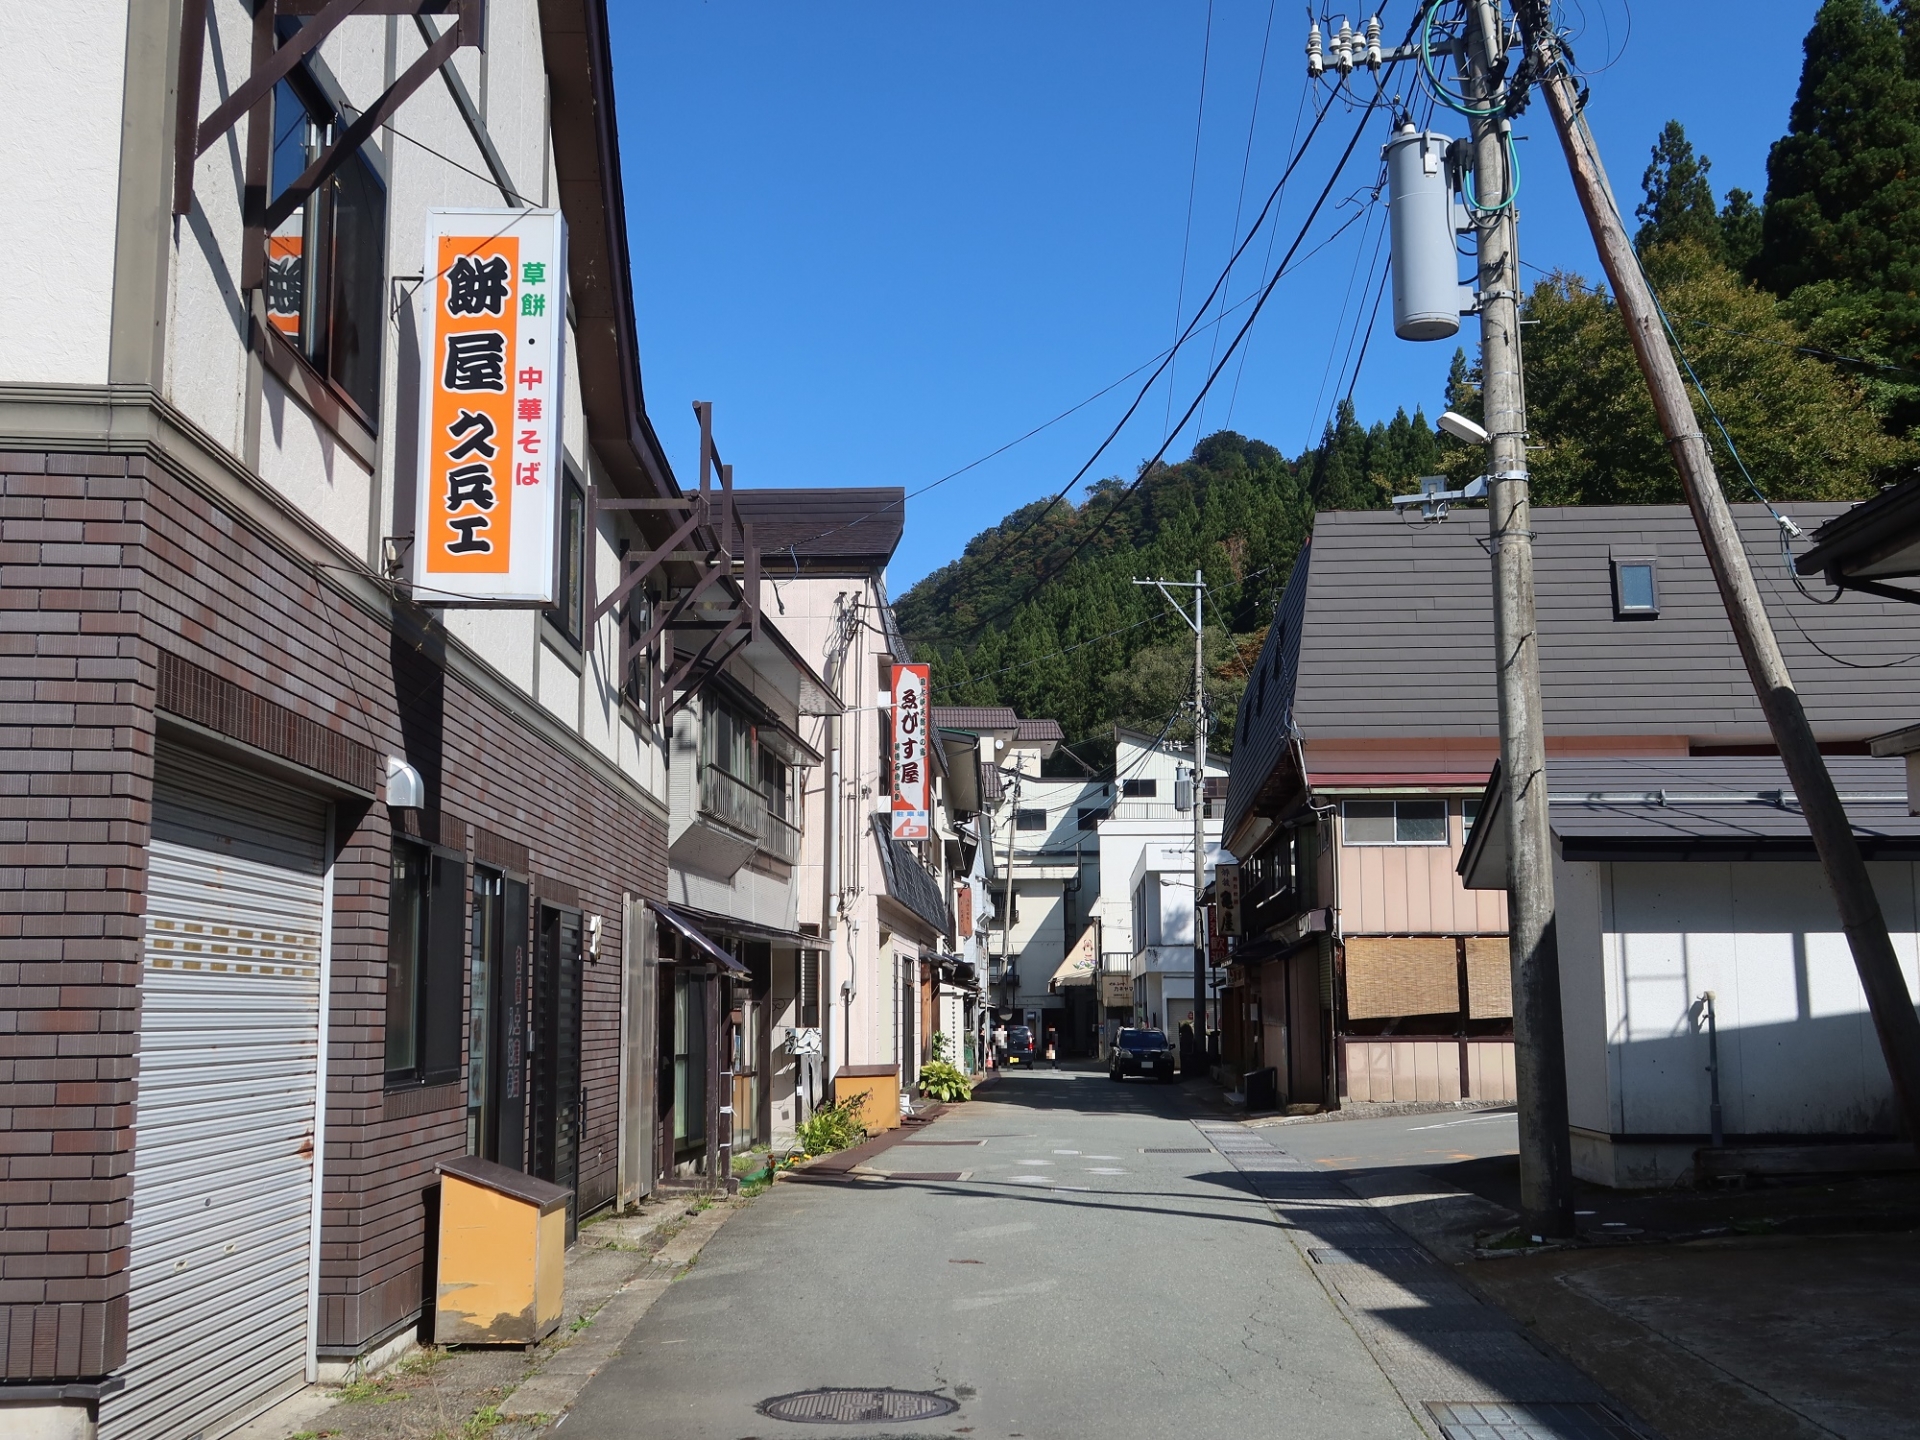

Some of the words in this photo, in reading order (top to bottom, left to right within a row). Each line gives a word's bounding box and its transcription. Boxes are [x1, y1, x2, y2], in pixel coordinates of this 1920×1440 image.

[900, 688, 920, 784] ゑびす屋
[903, 826, 919, 836] P
